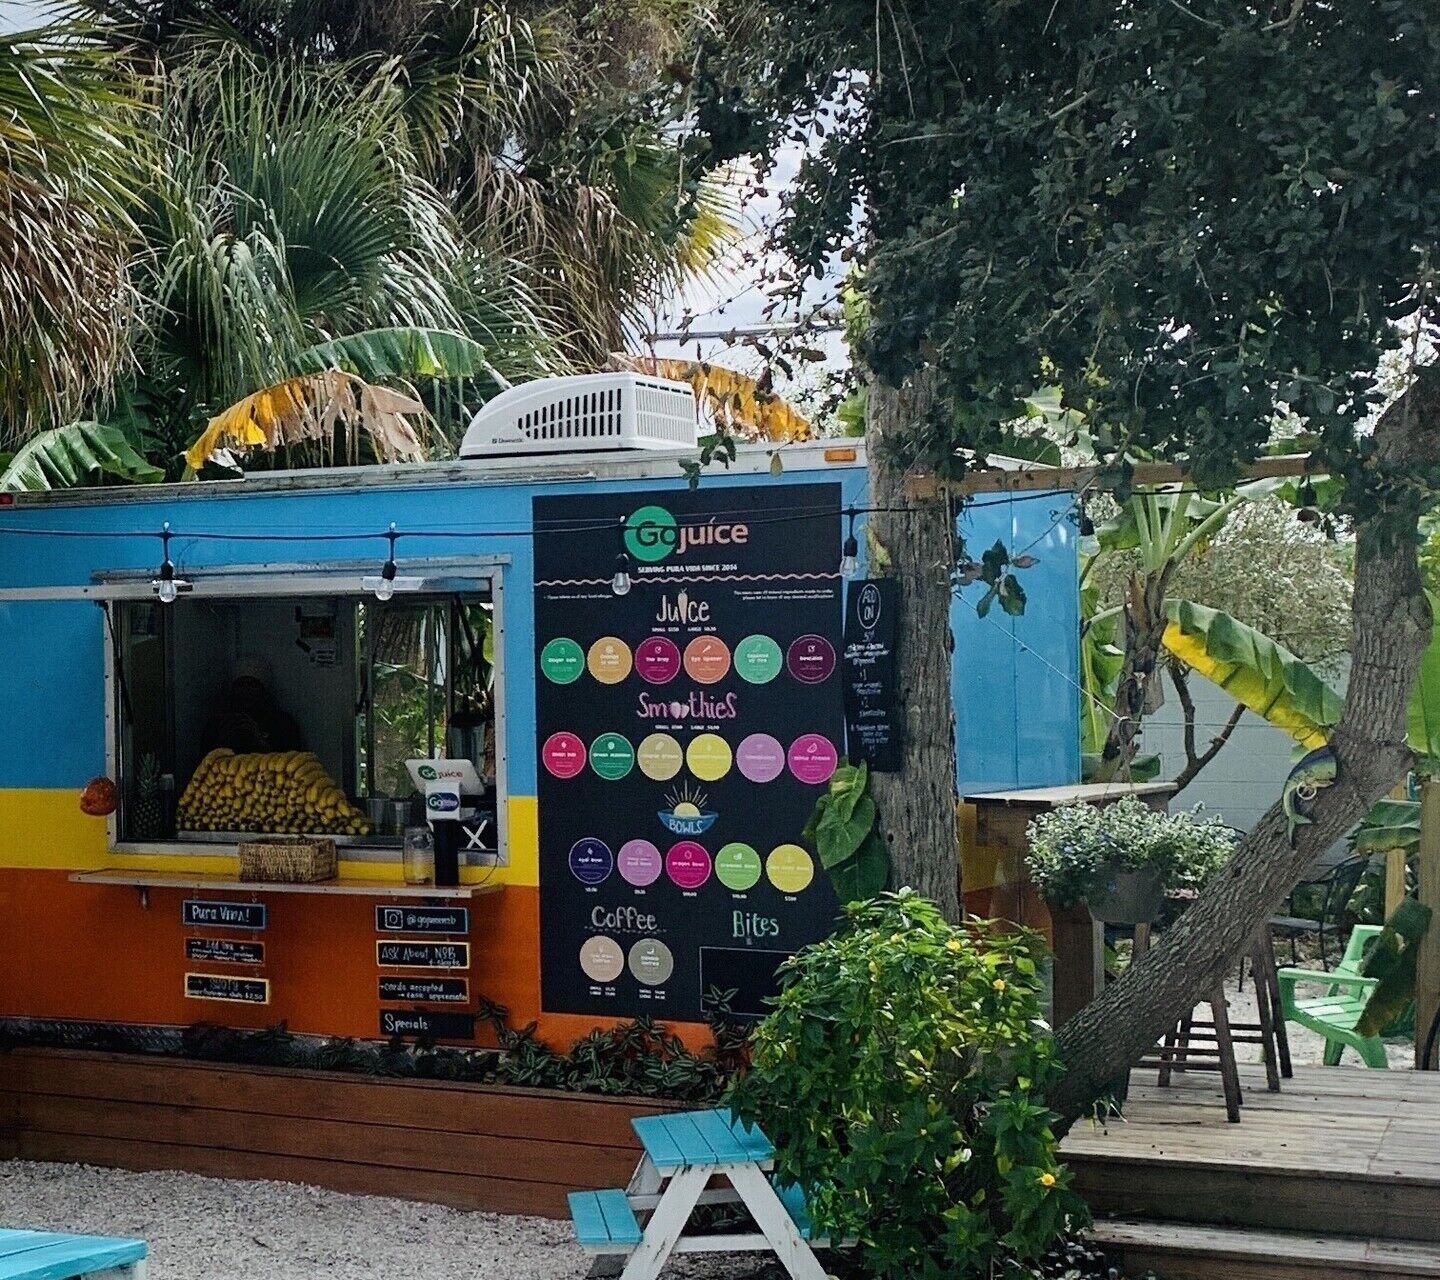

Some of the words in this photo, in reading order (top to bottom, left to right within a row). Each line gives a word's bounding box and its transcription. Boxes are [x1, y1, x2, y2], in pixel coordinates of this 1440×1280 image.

[666, 565, 685, 573] PURA
[701, 564, 720, 572] SINCE
[669, 818, 703, 834] BOWLS
[191, 905, 217, 920] Pura
[591, 905, 658, 930] Coffee
[732, 909, 779, 938] Bites
